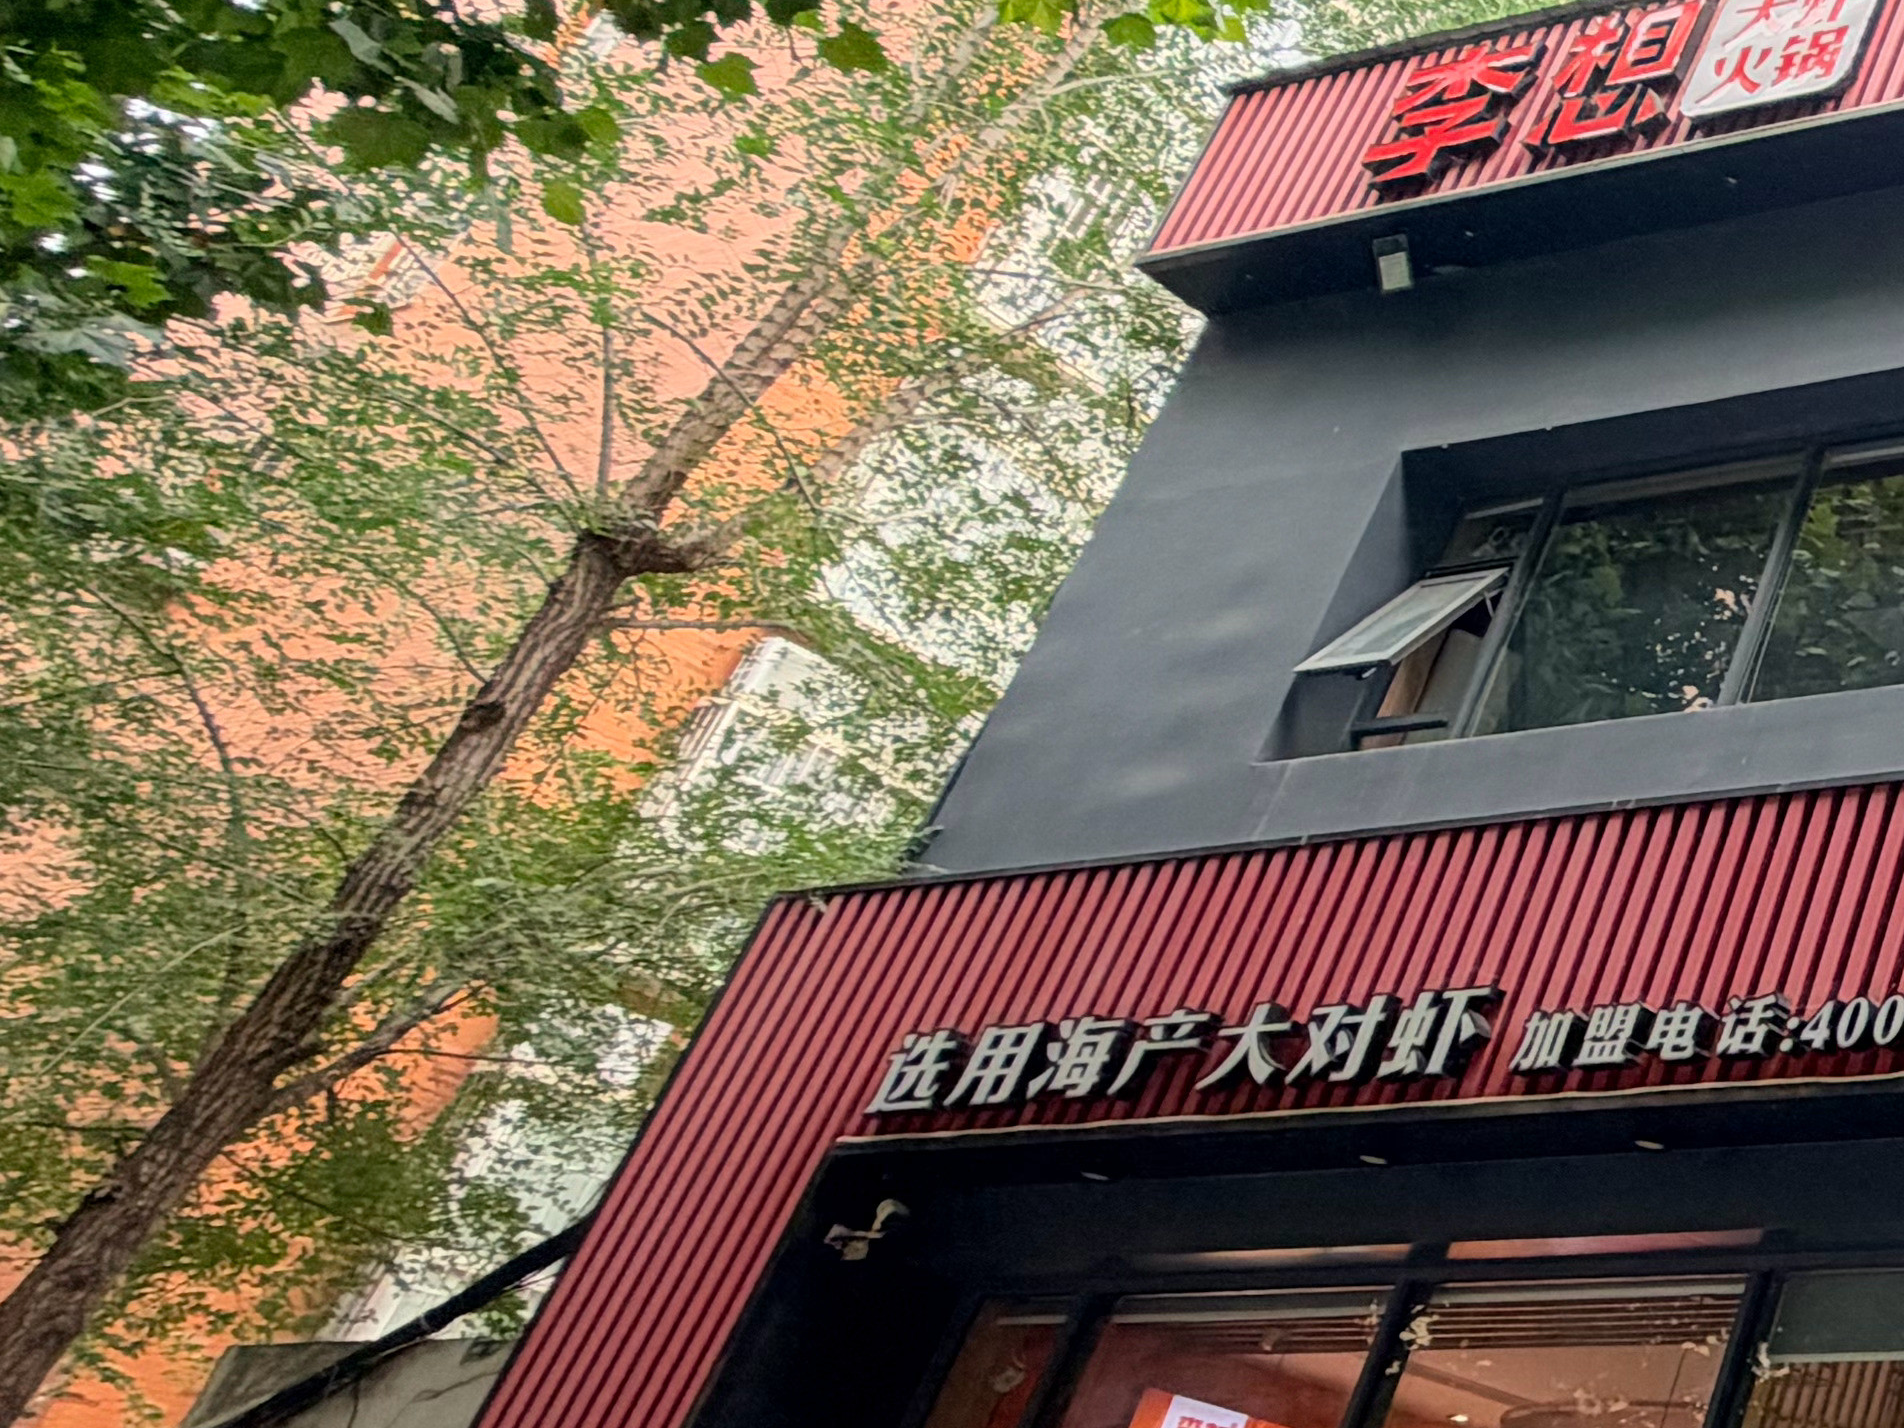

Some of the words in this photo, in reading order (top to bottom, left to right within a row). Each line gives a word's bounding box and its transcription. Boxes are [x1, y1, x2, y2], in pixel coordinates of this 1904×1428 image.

[1710, 22, 1848, 102] 火锅
[864, 984, 1496, 1118] 选用海产大对虾
